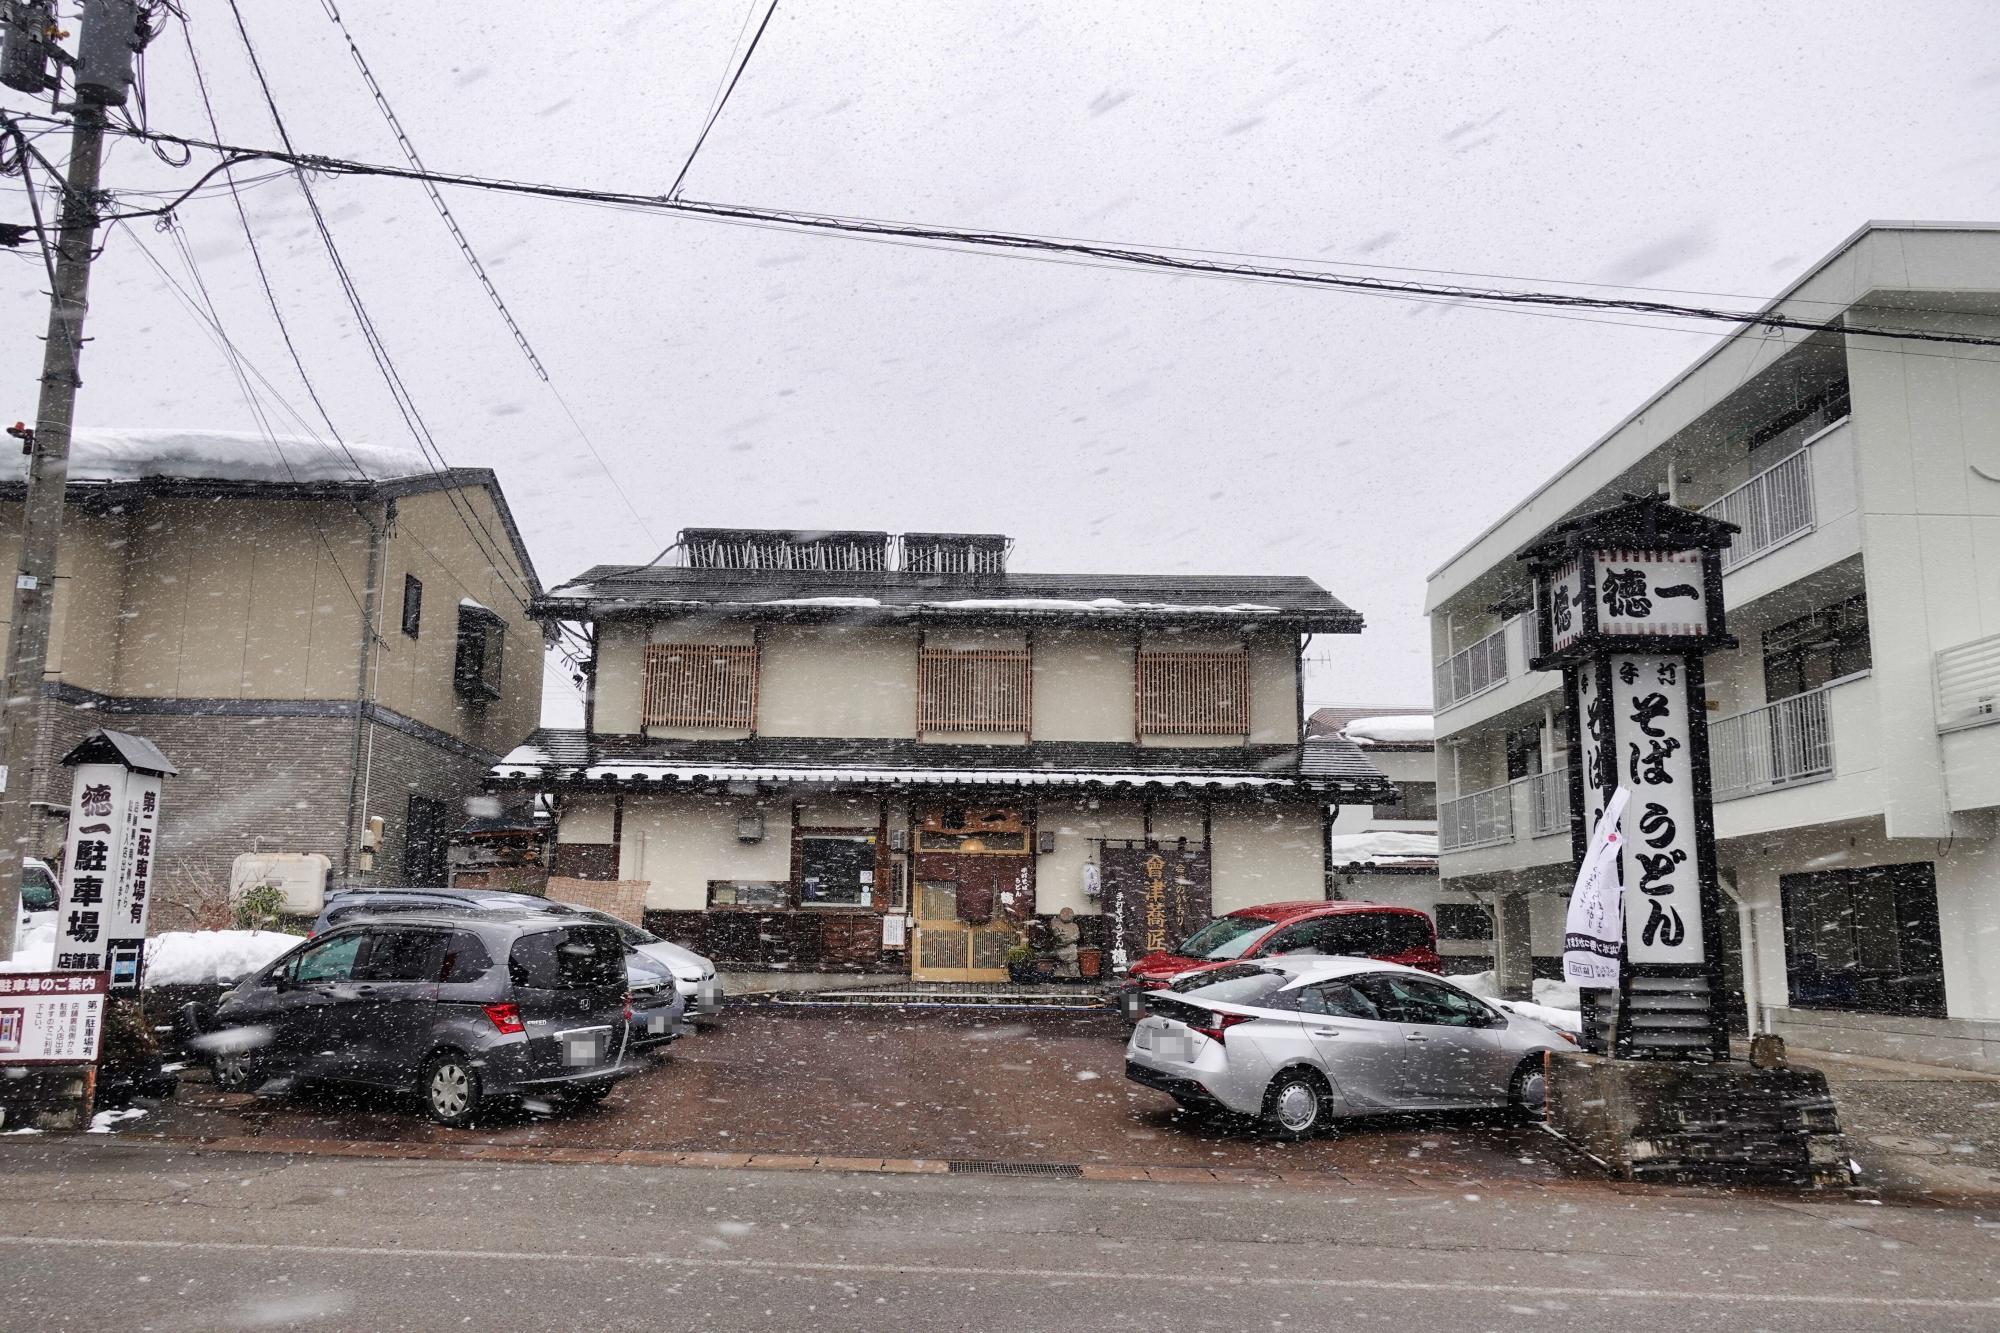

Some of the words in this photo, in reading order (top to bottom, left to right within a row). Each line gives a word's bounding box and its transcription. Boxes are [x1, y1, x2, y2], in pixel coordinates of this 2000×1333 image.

[1602, 567, 1700, 618] 徳一
[66, 783, 114, 943] 徳一駐車場
[130, 791, 156, 924] 第二駐車場有
[1145, 854, 1166, 951] 會津蕎匠
[57, 952, 102, 970] 店舗裏
[83, 1000, 98, 1056] 第二駐車場有
